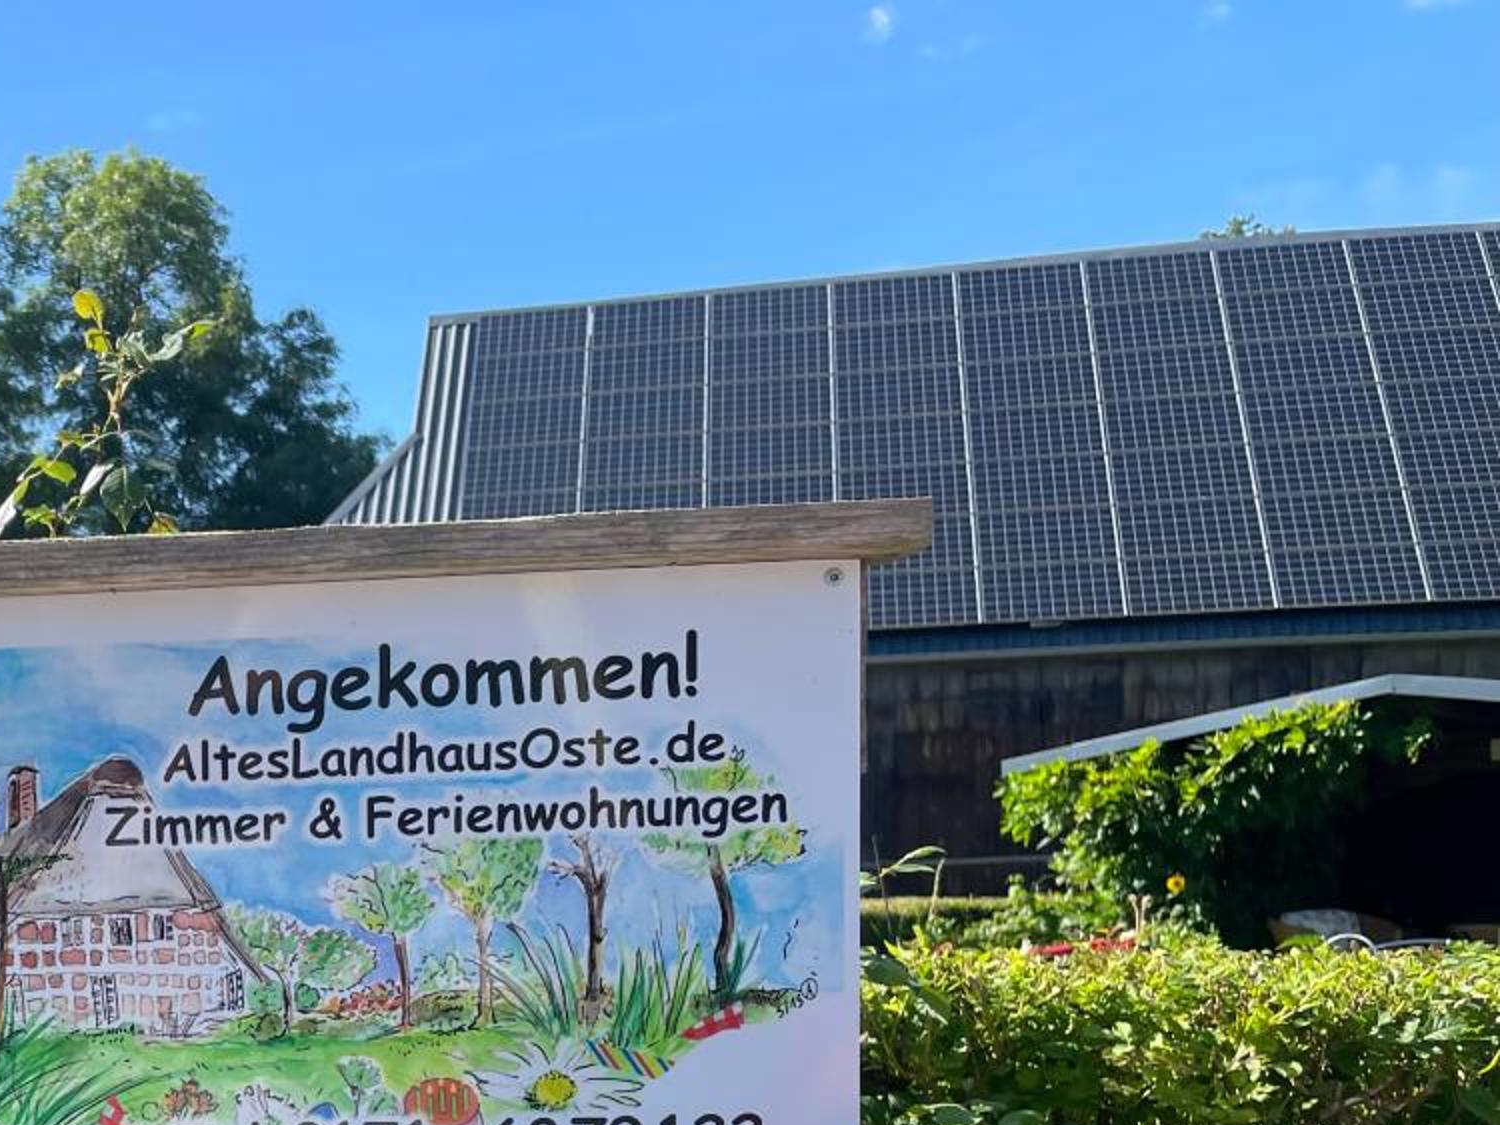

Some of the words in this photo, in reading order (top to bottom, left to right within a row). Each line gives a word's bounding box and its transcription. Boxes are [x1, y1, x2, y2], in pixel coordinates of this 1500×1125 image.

[188, 629, 699, 734] Angekommen!
[163, 719, 726, 783] AltesLandhausOste.de
[105, 806, 286, 847] Zimmer
[309, 800, 343, 841] &
[365, 786, 788, 839] Ferienwohnungen
